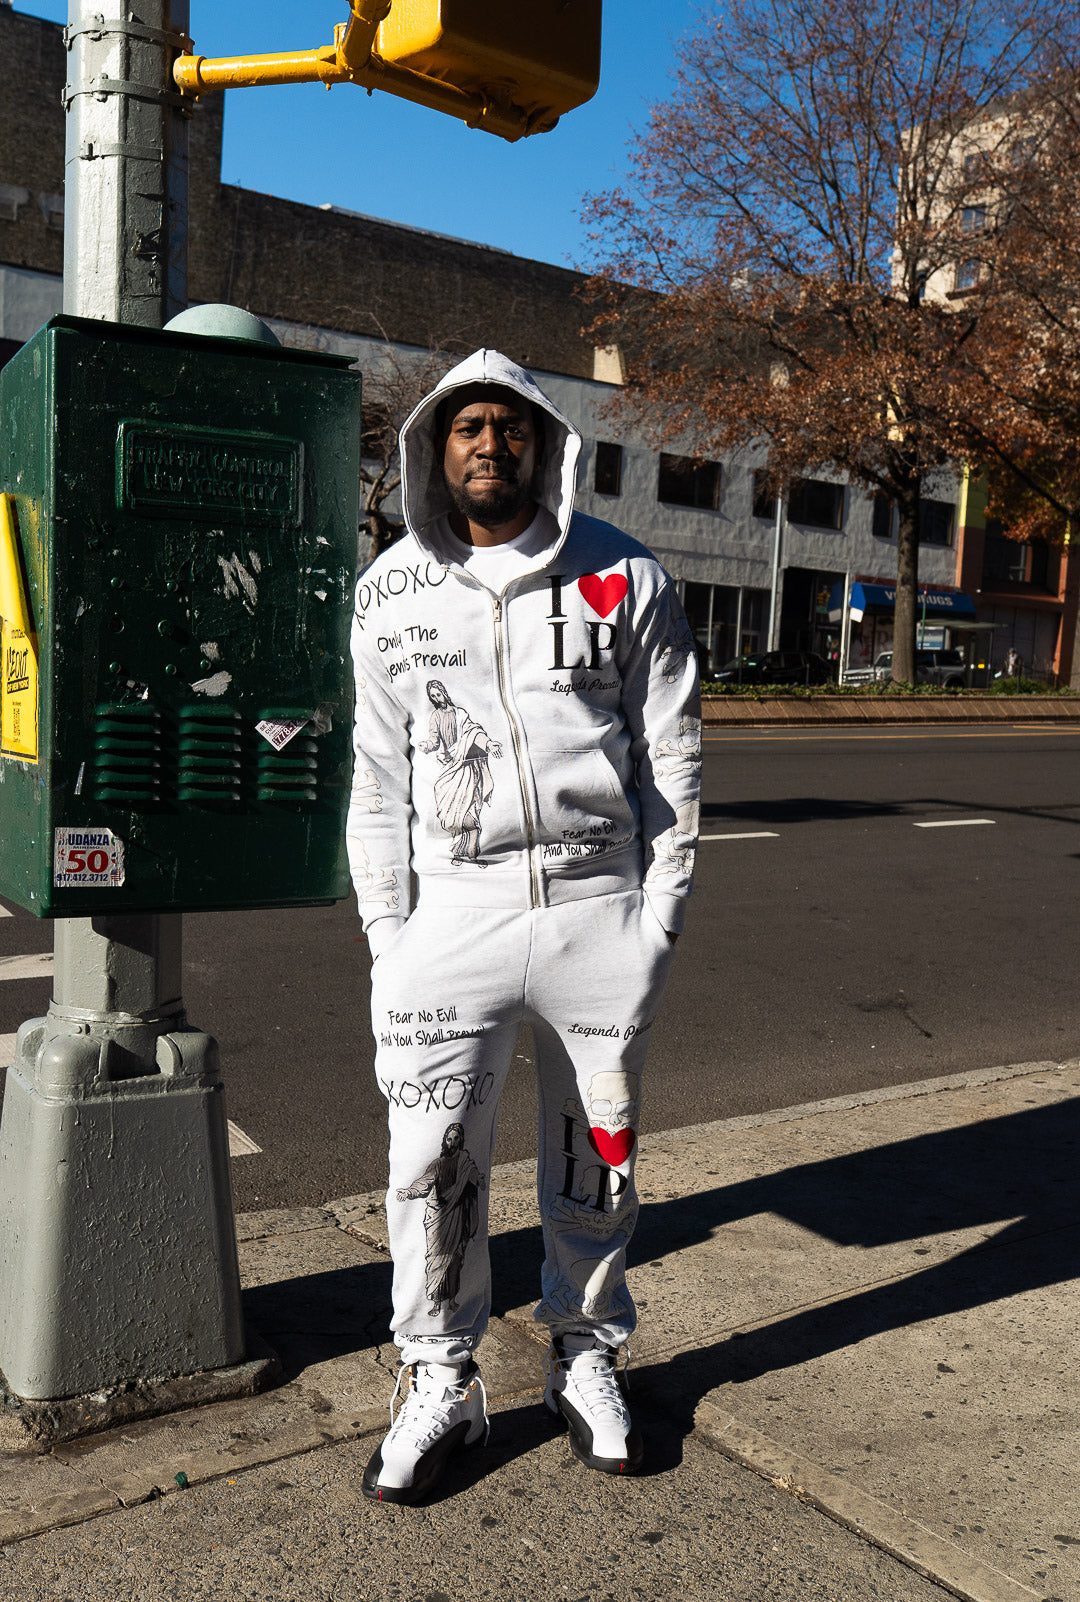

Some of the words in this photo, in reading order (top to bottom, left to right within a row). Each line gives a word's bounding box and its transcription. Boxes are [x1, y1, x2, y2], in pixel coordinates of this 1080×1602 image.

[545, 574, 568, 618] I
[404, 624, 439, 642] The
[547, 621, 617, 671] LP
[411, 648, 467, 668] Prevail
[562, 829, 587, 840] Fear
[589, 825, 602, 837] No
[543, 840, 563, 859] And
[564, 844, 582, 856] You
[584, 839, 607, 857] Shall
[388, 1010, 413, 1026] Fear
[418, 1009, 433, 1023] No
[436, 1005, 458, 1022] Evil
[380, 1031, 392, 1048] And
[393, 1032, 413, 1047] You
[415, 1028, 444, 1046] Shall
[567, 1023, 620, 1038] Legends
[380, 1071, 495, 1113] XOXOXO
[559, 1112, 580, 1156] I
[556, 1153, 629, 1214] LP
